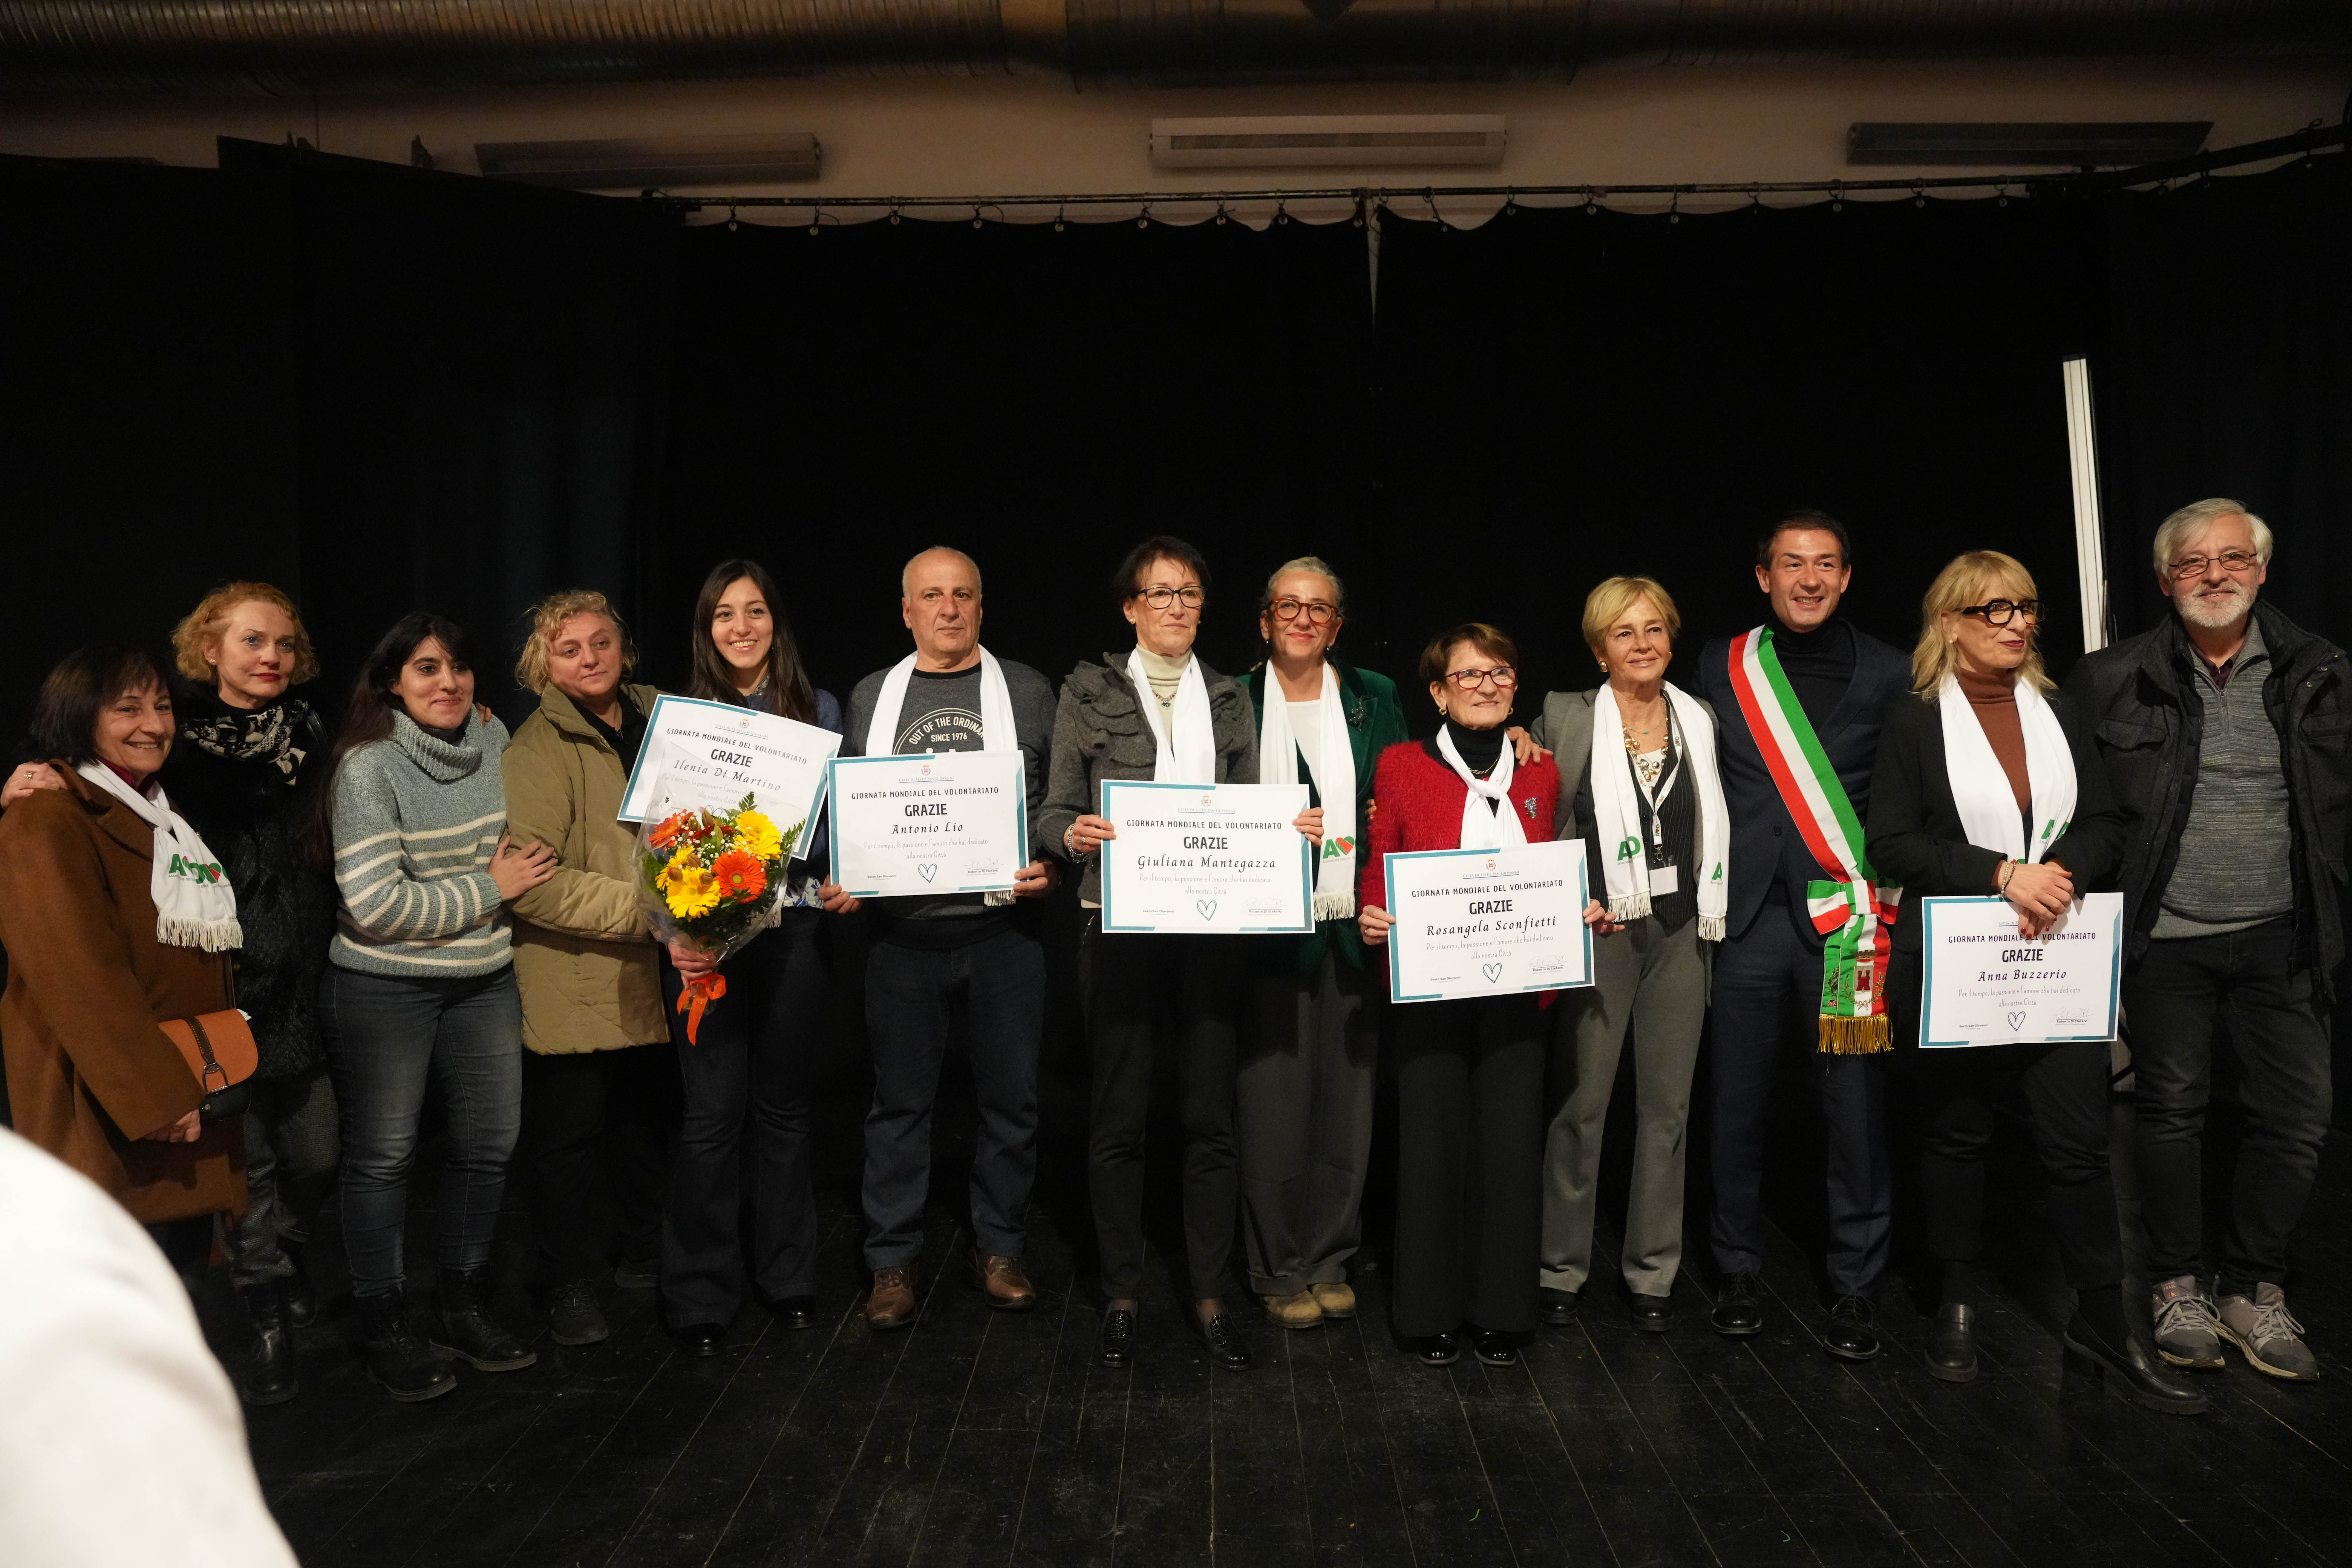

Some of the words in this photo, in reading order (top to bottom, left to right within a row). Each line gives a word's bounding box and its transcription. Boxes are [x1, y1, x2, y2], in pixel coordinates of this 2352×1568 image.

[909, 729, 924, 745] OUT
[923, 721, 934, 733] OF
[935, 717, 951, 728] THE
[931, 733, 950, 742] SINCE
[952, 732, 967, 741] 1976
[667, 728, 699, 738] GIORNATA
[702, 733, 737, 745] MONDIALE
[755, 745, 806, 764] VOLONTARIATO
[711, 749, 753, 767] GRAZIE
[674, 760, 708, 773] Ilenia
[714, 768, 727, 778] Di
[732, 772, 780, 790] Martino
[697, 790, 706, 799] alla
[724, 796, 736, 804] Città
[905, 804, 947, 816] GRAZIE
[891, 824, 938, 834] Antonio
[945, 822, 962, 831] Lio
[1184, 836, 1228, 849] GRAZIE
[934, 850, 946, 859] Città
[1138, 854, 1193, 869] Giuliana
[1200, 855, 1275, 873] Mantegazza
[1174, 873, 1179, 882] la
[1249, 874, 1270, 882] dedicato
[1213, 887, 1226, 895] Città
[1412, 889, 1449, 897] GIORNATA
[1453, 886, 1490, 894] MONDIALE
[1510, 880, 1562, 890] VOLONTARIATO
[1469, 899, 1513, 914] GRAZIE
[1427, 920, 1488, 938] Rosangela
[1496, 916, 1555, 933] Sconfietti
[1437, 942, 1439, 950] il
[1514, 935, 1522, 943] che
[1533, 933, 1553, 942] dedicato
[2002, 949, 2043, 962] GRAZIE
[1978, 971, 2007, 981] Anna
[2014, 969, 2066, 979] Buzzerio
